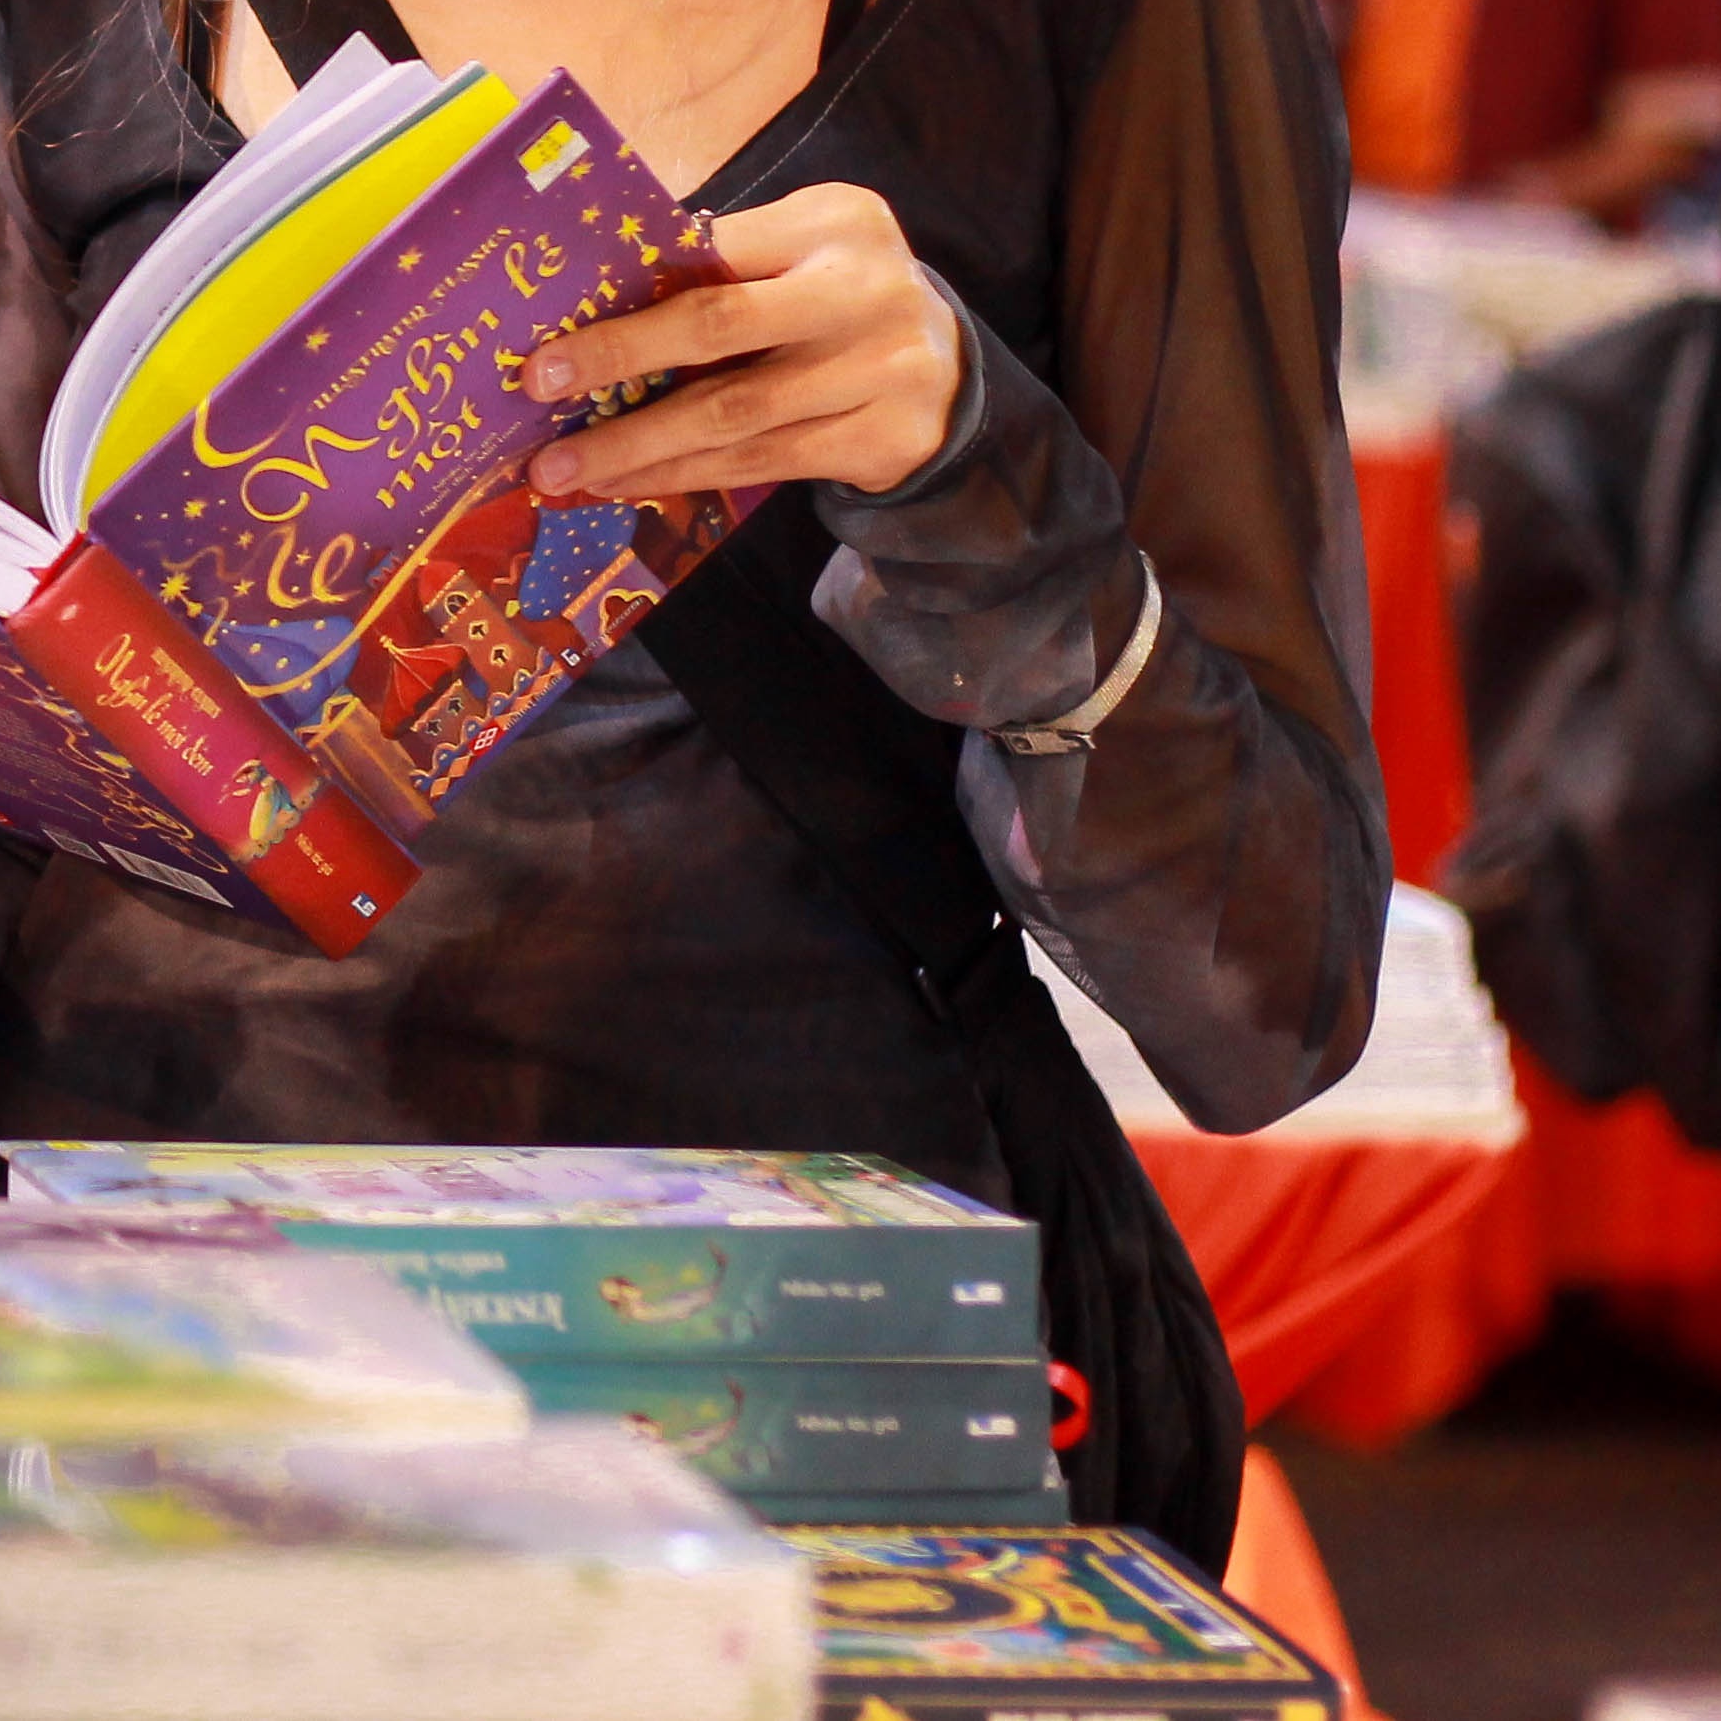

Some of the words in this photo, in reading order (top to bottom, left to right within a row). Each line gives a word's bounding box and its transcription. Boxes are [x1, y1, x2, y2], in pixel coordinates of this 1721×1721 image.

[240, 309, 500, 522] Nghìn
[504, 233, 568, 298] lẻ
[376, 397, 482, 509] một
[94, 633, 151, 708] Nghìn
[181, 734, 214, 778] đêm
